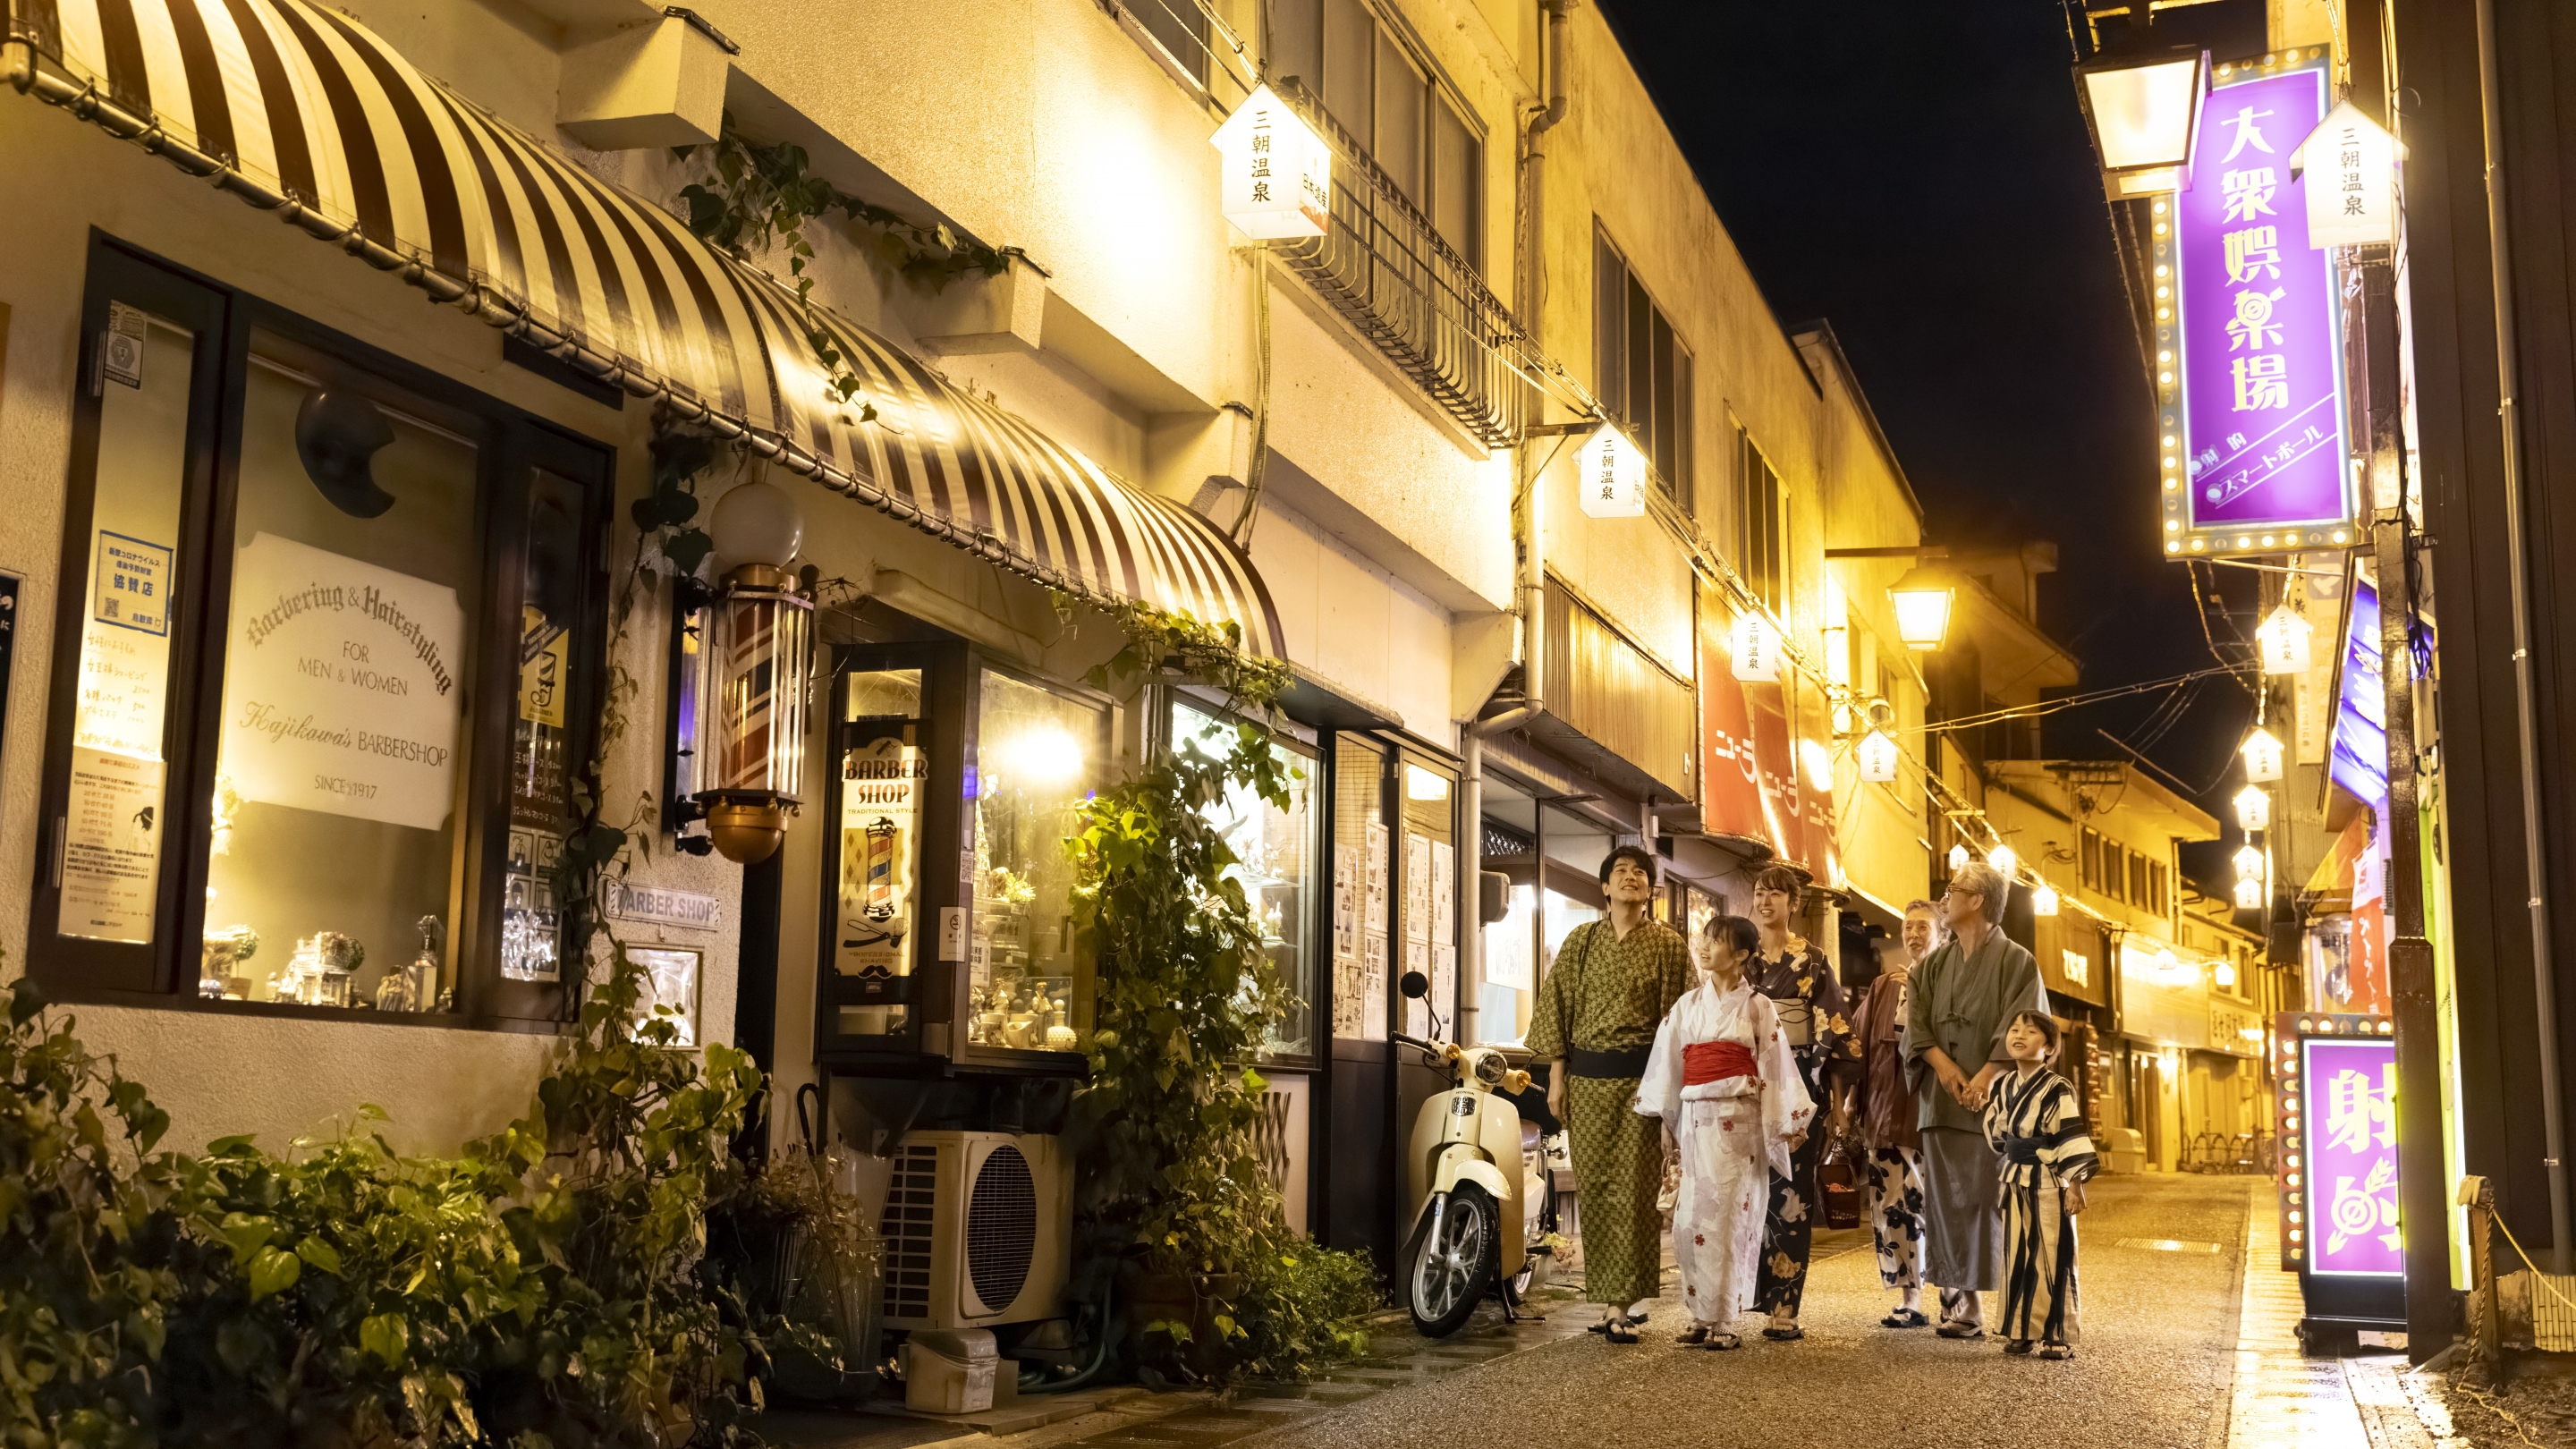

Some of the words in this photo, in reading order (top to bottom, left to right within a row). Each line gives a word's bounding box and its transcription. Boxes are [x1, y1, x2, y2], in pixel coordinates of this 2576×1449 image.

[1251, 110, 1272, 203] 三朝温泉
[2340, 127, 2367, 216] 三朝温泉
[1303, 173, 1328, 208] 日本遺産
[2220, 106, 2289, 411] 大衆娯楽場
[1600, 439, 1614, 500] 三朝温泉
[2218, 425, 2323, 496] スマートボール
[114, 573, 154, 597] 協賛店
[246, 581, 343, 650] Barbering
[347, 587, 360, 607] &
[361, 585, 453, 697] Hairstyling
[343, 640, 369, 664] FOR
[1748, 622, 1759, 669] 三朝温泉
[2278, 616, 2294, 661] 三朝温泉
[298, 657, 332, 679] MEN
[337, 668, 346, 682] &
[352, 667, 408, 696] WOMEN
[239, 700, 352, 749] Kajikawa's
[358, 731, 448, 767] BARBERSHOP
[315, 775, 345, 795] SINCE
[353, 783, 377, 800] 1917
[844, 759, 927, 780] BARBER
[858, 784, 910, 804] SHOP
[677, 898, 715, 922] SHOP
